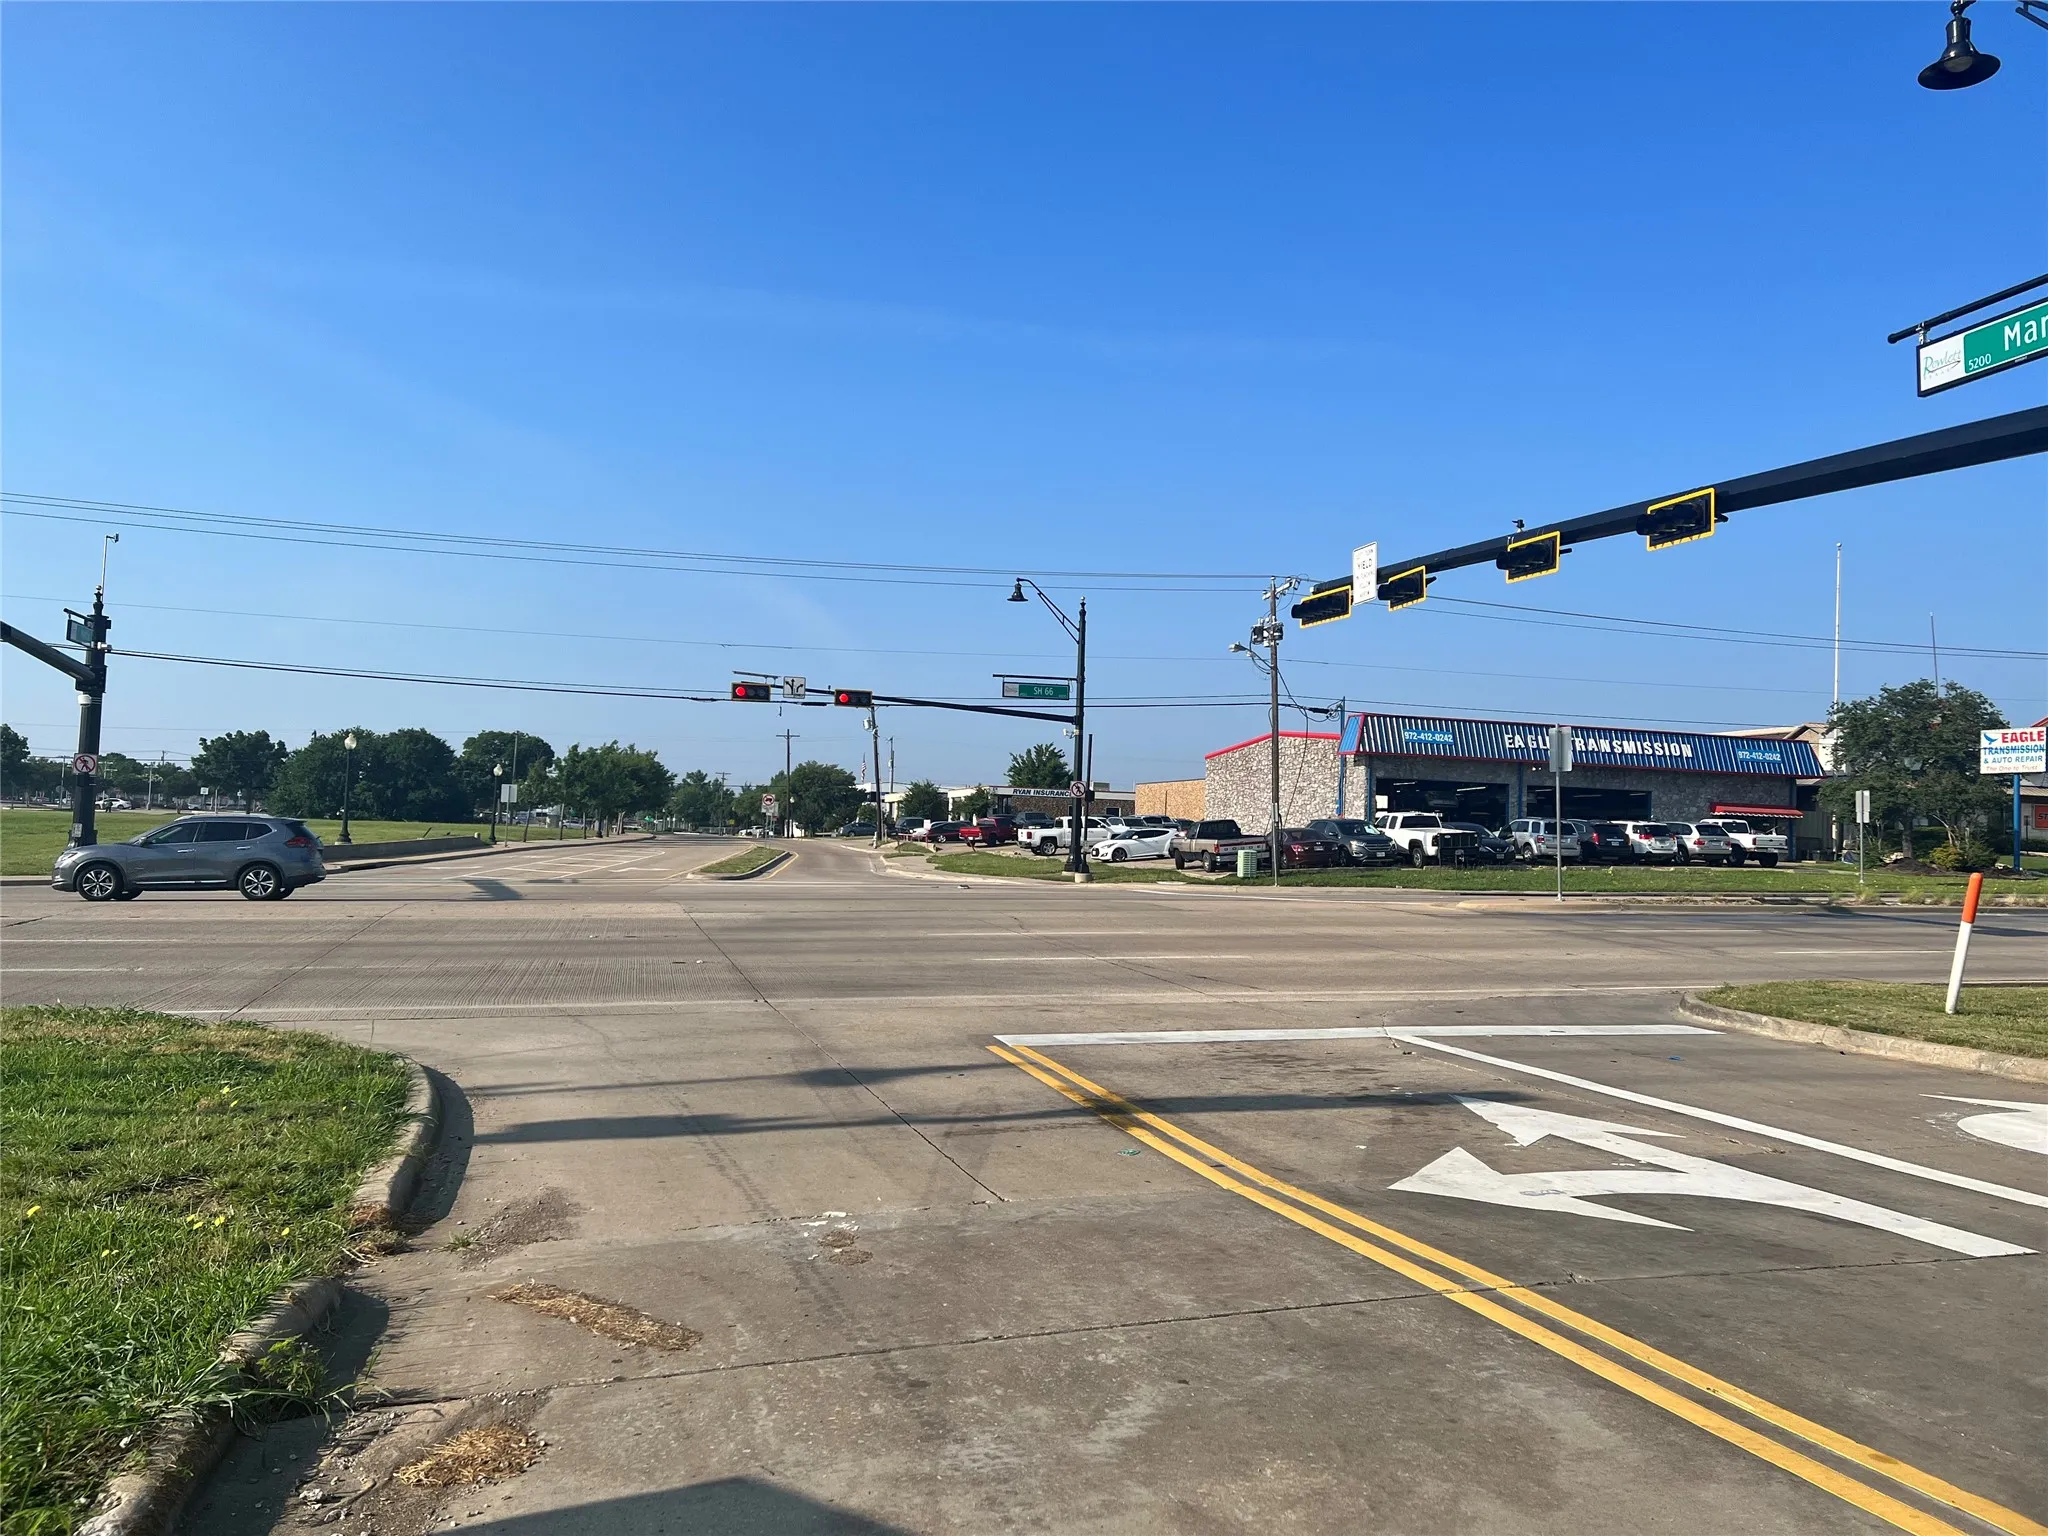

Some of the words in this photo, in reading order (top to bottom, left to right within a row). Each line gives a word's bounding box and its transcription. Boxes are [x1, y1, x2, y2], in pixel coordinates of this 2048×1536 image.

[1968, 353, 1992, 370] 5200
[1033, 686, 1043, 696] SH
[1044, 687, 1054, 696] 66
[1404, 731, 1454, 743] 972-412-0242
[2001, 730, 2045, 744] EAGLE
[1571, 736, 1693, 759] RANSMISSION
[1983, 744, 2045, 756] TRANSMISSION
[1738, 750, 1781, 761] 972-412-0242
[1991, 756, 2013, 764] AUTO
[2015, 755, 2043, 763] REPAIR
[1033, 789, 1071, 797] INSURANC
